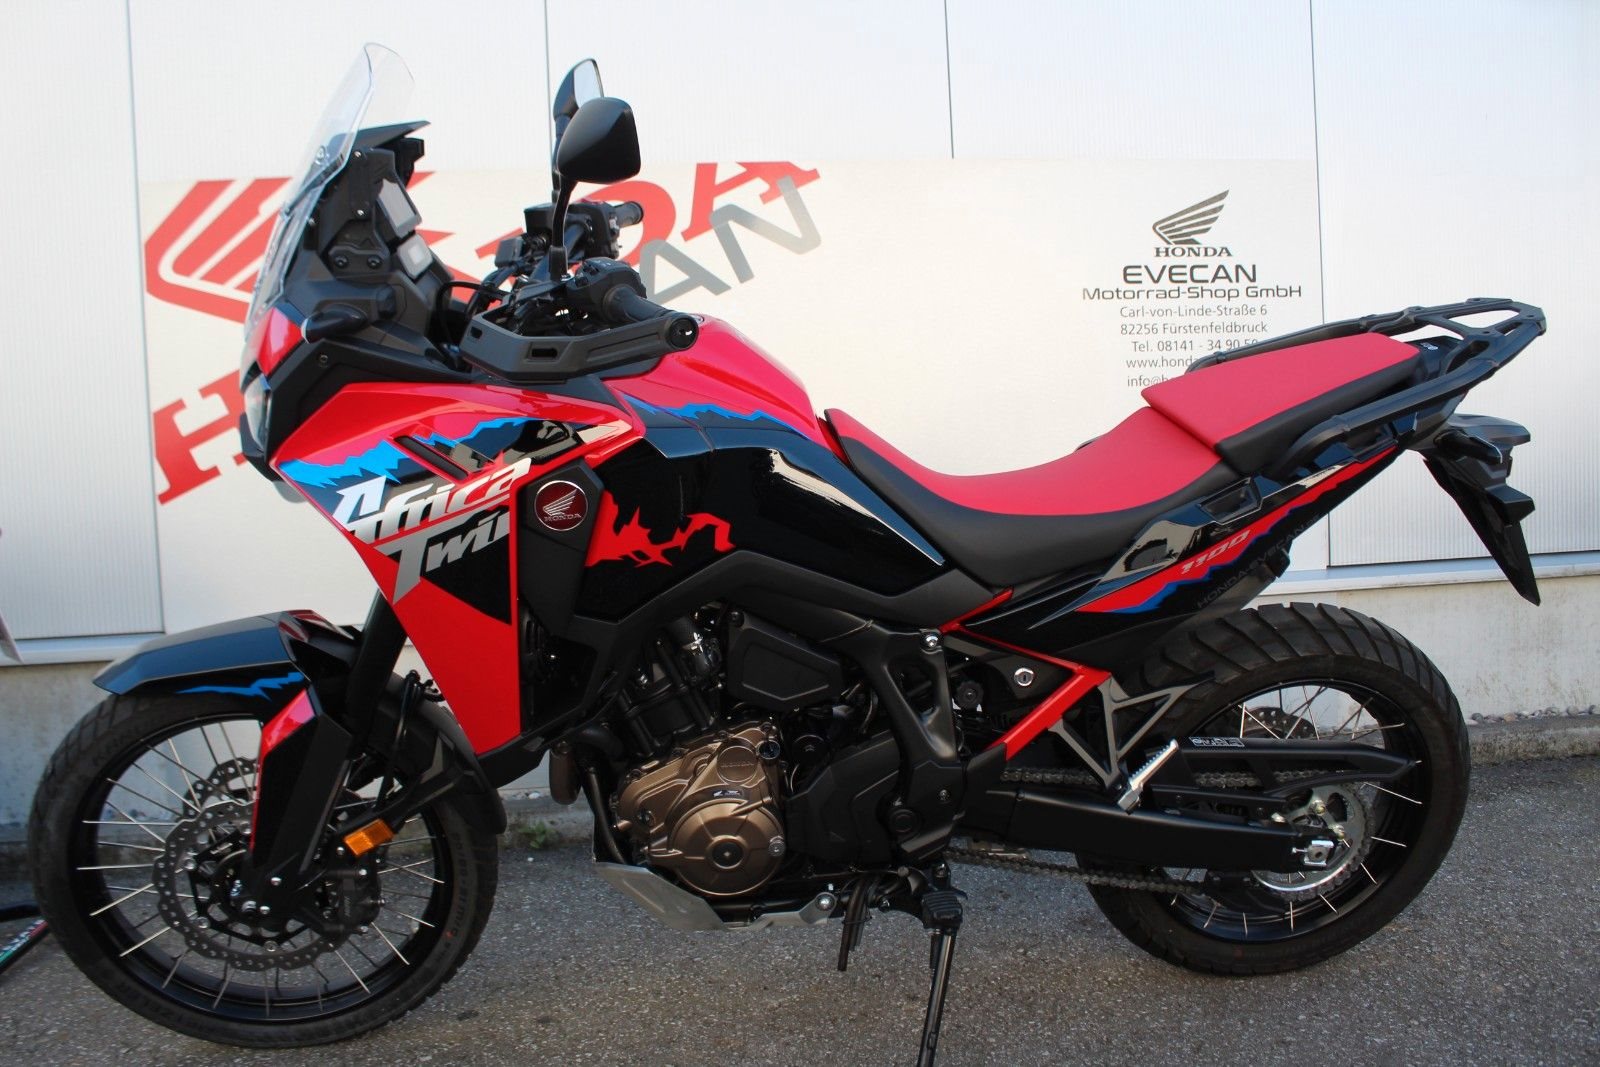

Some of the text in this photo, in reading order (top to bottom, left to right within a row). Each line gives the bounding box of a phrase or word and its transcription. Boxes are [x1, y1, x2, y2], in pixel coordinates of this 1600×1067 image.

[1155, 246, 1232, 258] HONDA
[1122, 263, 1257, 285] EVECAN
[1082, 285, 1302, 302] Motorrad-Shop GmbH
[1120, 304, 1268, 318] Carl-von-Linde-Straße 6
[1120, 321, 1268, 335] 82256 Fürstenfeldbruck
[1131, 341, 1153, 352] Tel.
[1157, 340, 1194, 351] 08141
[1207, 339, 1222, 351] 34
[1225, 338, 1240, 350] 90
[1126, 355, 1197, 368] www.hond
[1127, 375, 1169, 387] info@h
[331, 457, 532, 545] Africa
[544, 513, 582, 522] HONDA
[1181, 529, 1250, 575] 1100
